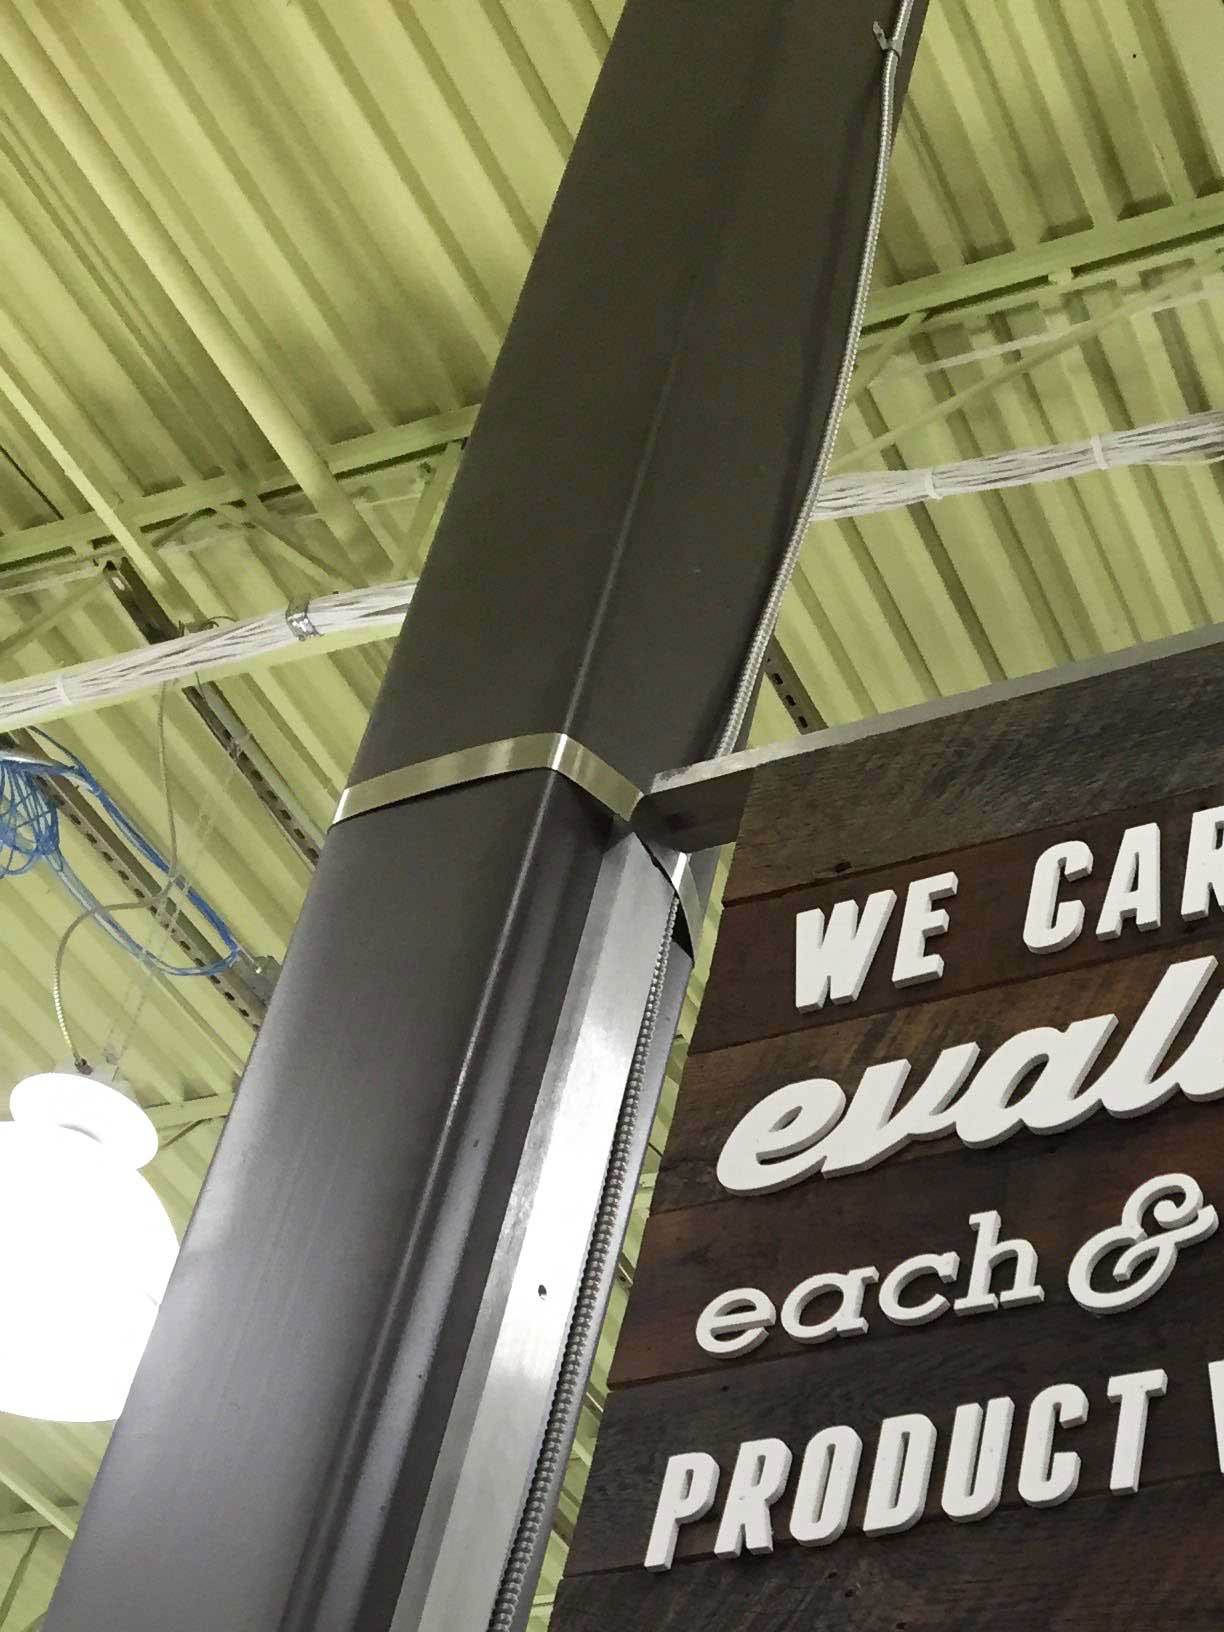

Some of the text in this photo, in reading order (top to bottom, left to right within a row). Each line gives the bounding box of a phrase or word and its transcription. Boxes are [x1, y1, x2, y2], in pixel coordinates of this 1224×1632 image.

[796, 872, 959, 1010] WE
[696, 1211, 1044, 1358] each
[1067, 1172, 1219, 1314] &
[644, 1369, 1168, 1571] PRODUCT
